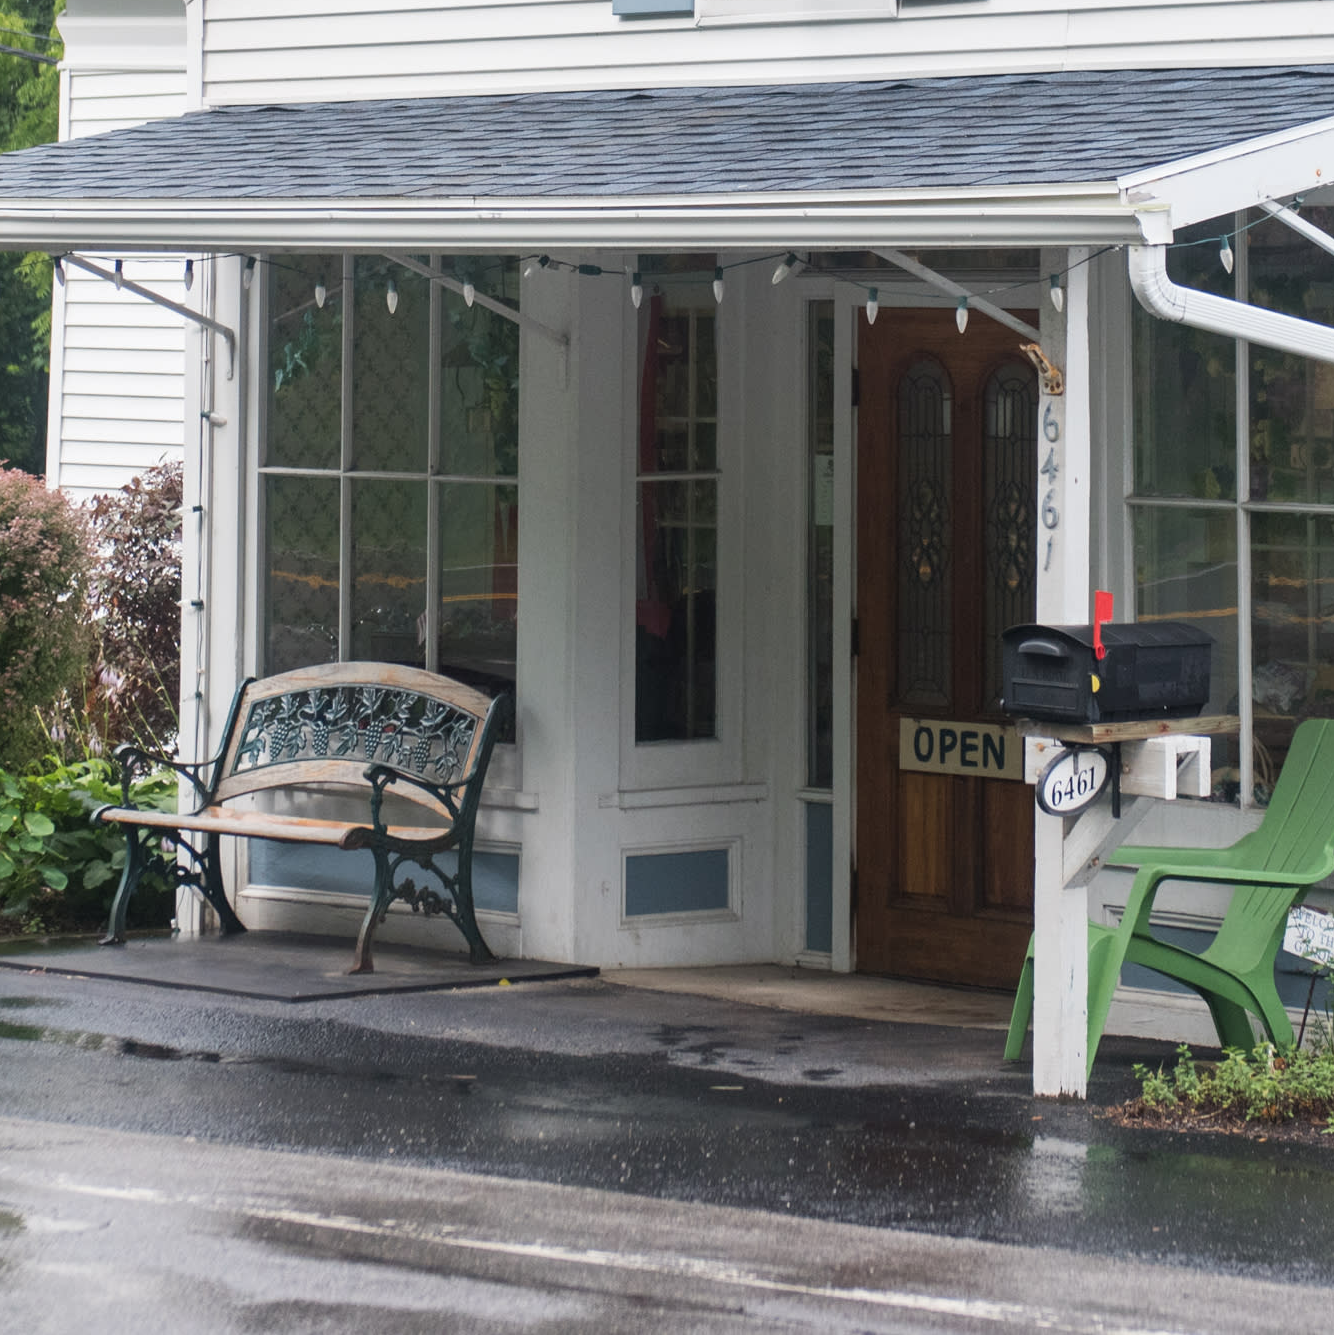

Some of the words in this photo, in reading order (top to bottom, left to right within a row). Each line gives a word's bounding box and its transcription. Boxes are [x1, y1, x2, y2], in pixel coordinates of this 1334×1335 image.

[1040, 401, 1059, 572] 6461
[913, 726, 1005, 770] OPEN
[1051, 766, 1097, 807] 6461
